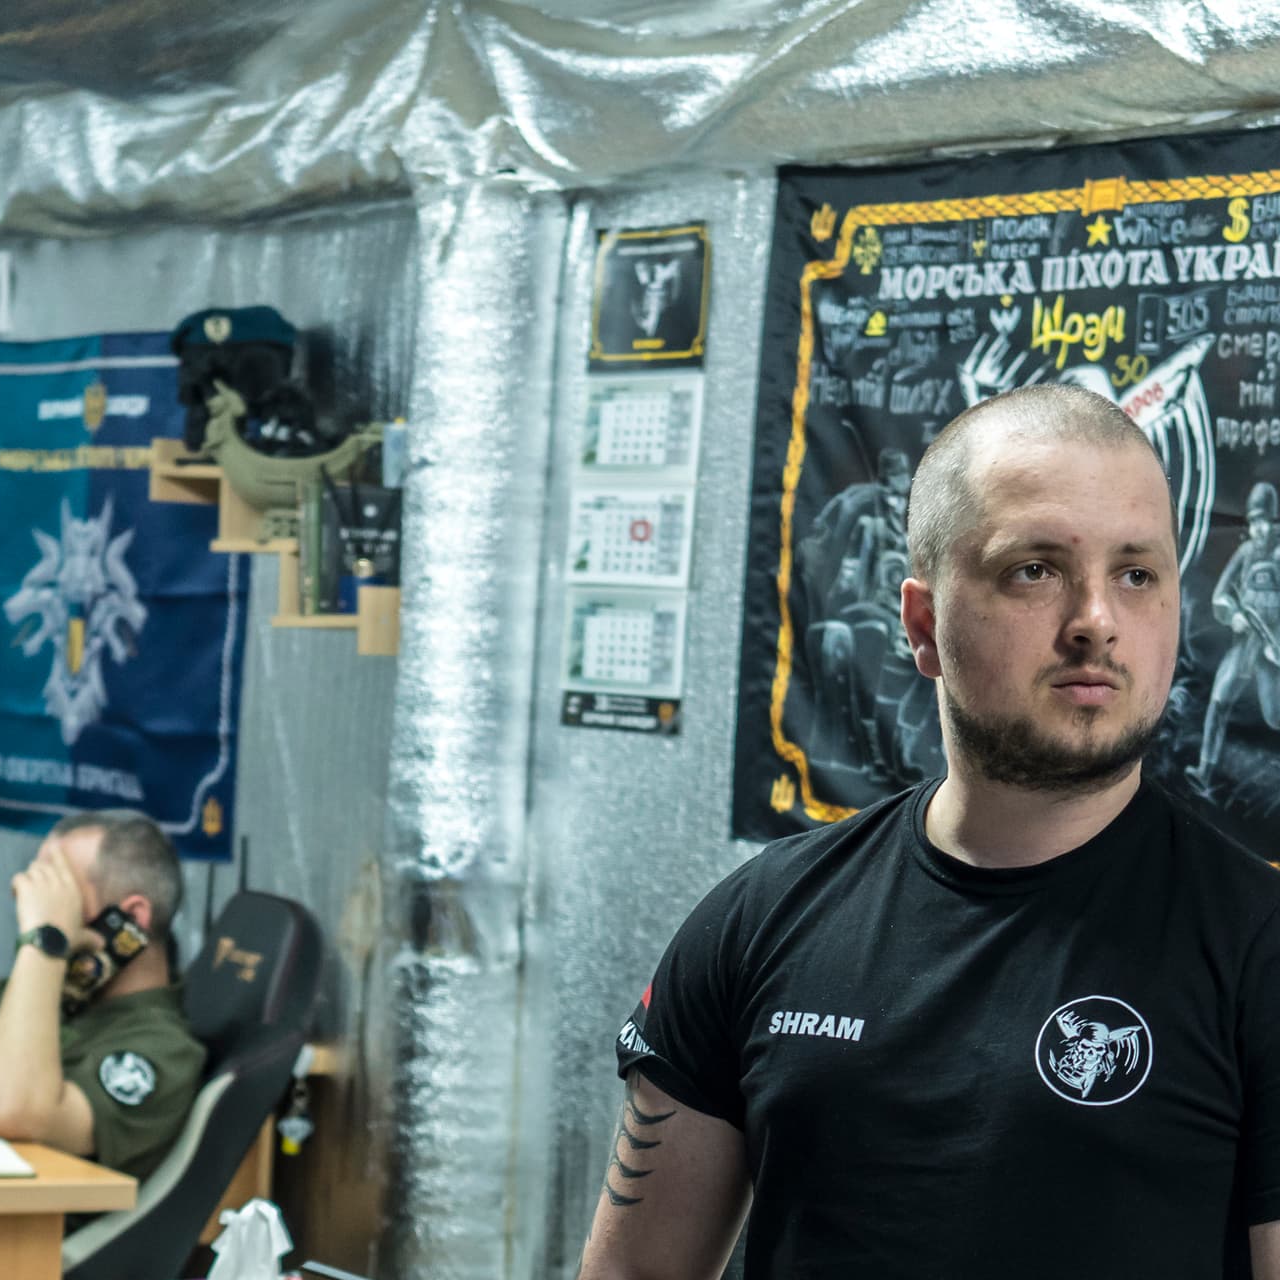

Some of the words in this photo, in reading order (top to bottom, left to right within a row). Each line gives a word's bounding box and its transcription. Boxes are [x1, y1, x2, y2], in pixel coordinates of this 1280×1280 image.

[878, 259, 1036, 301] МОРСЬКА
[1041, 247, 1171, 293] ПІХОТА
[768, 1011, 865, 1041] SHRAM
